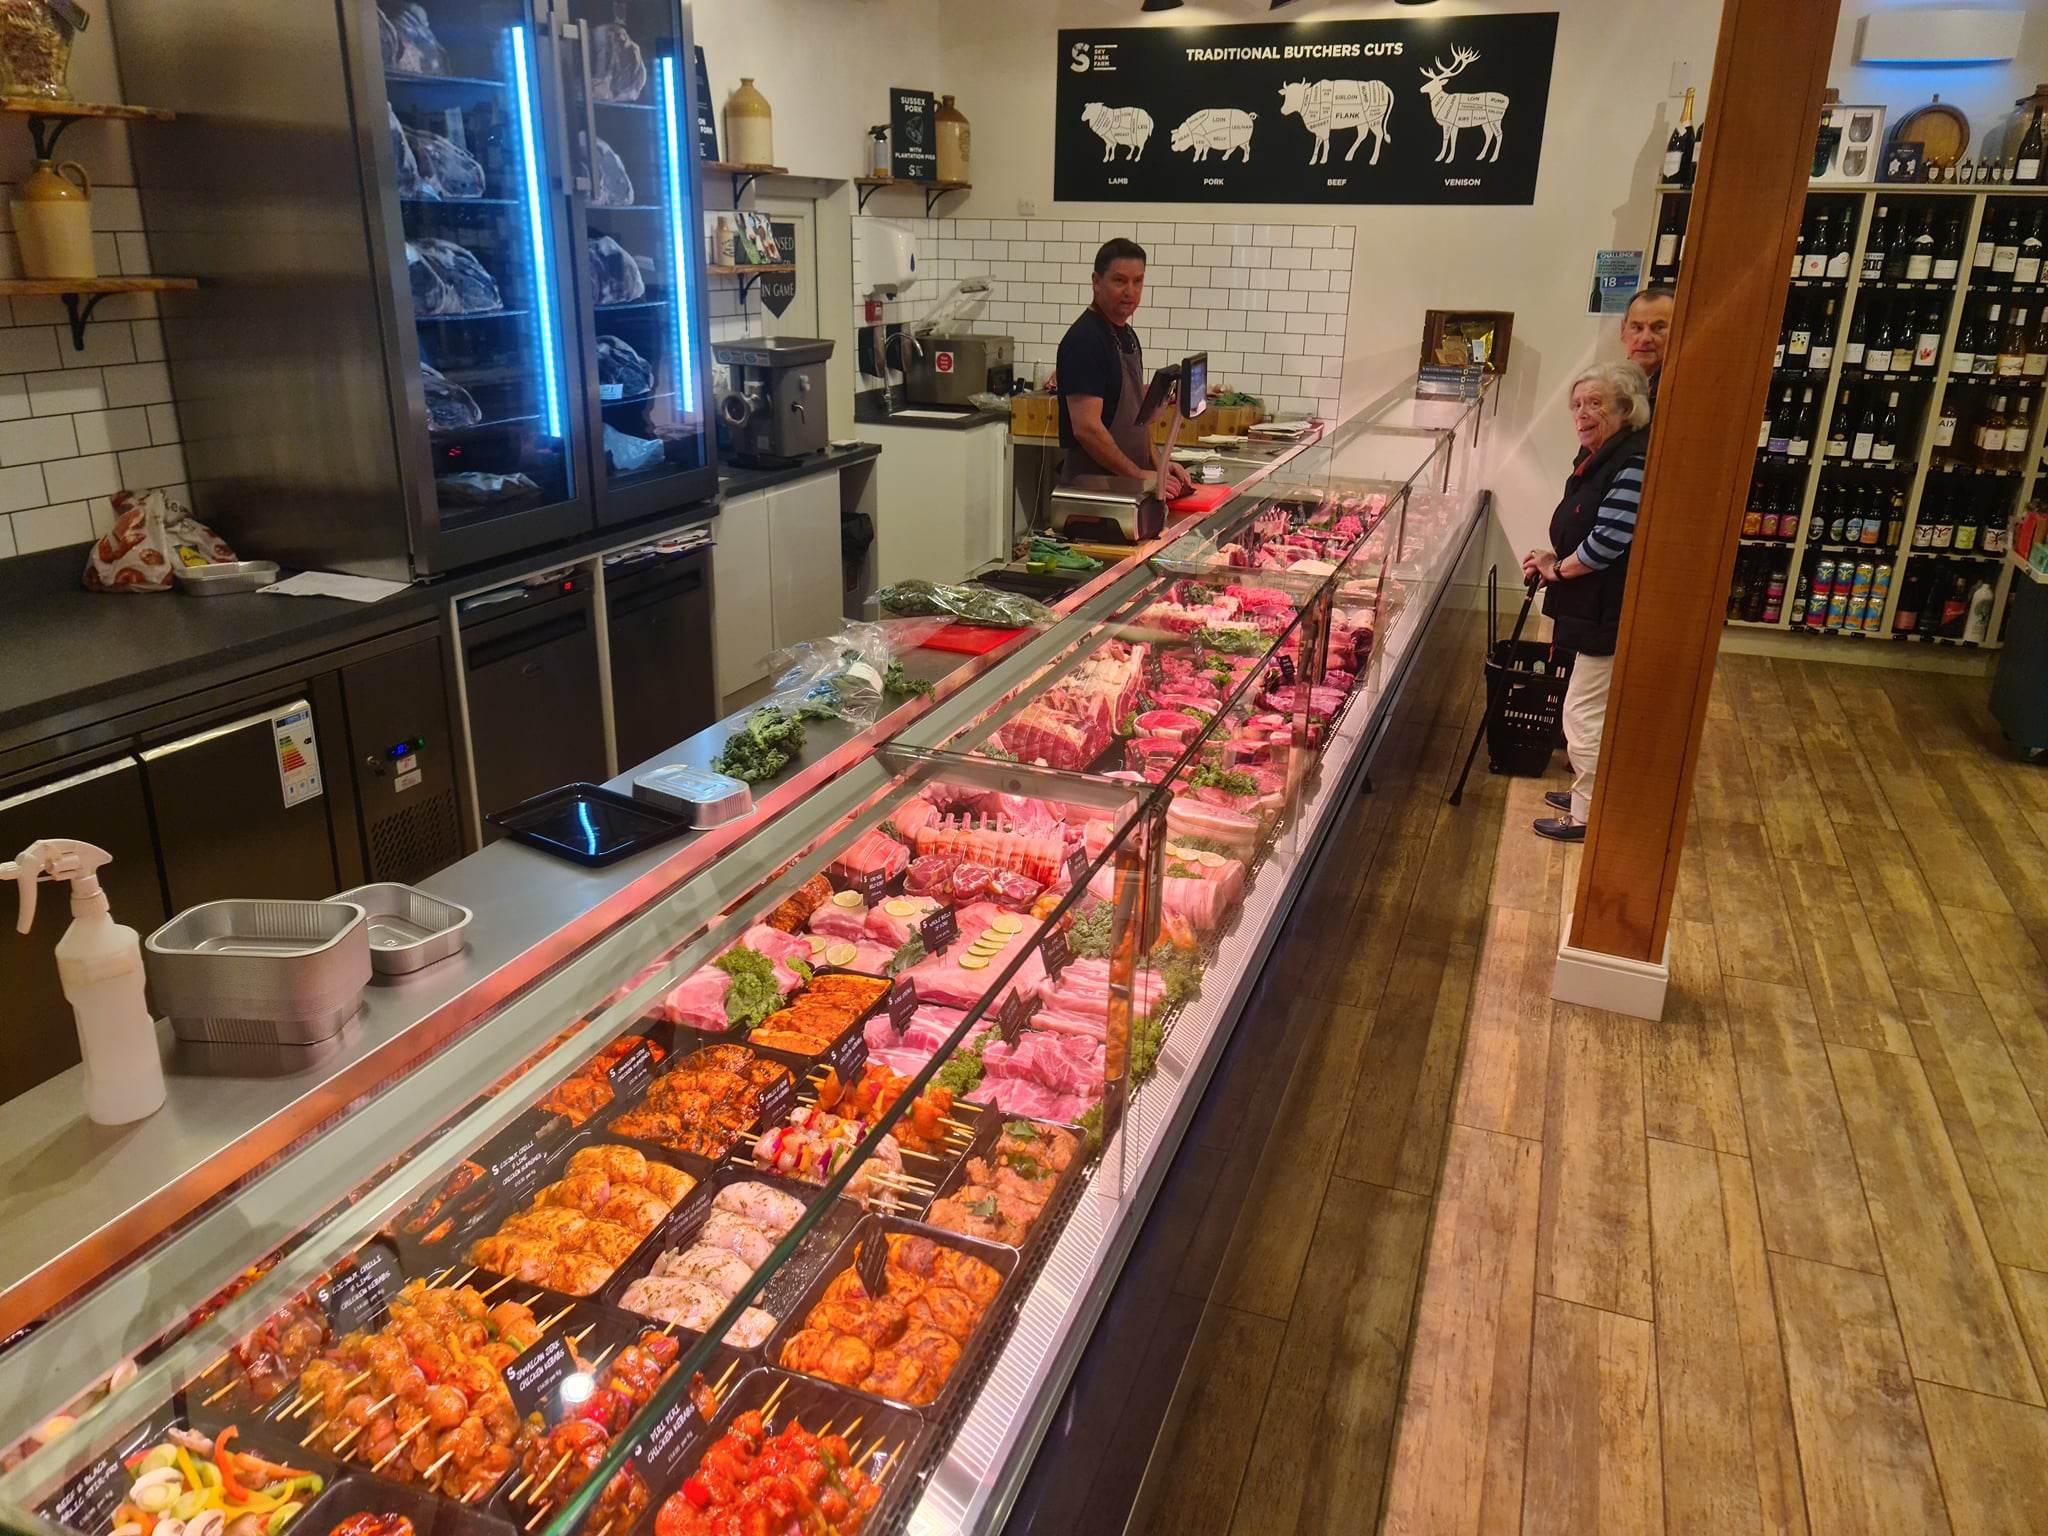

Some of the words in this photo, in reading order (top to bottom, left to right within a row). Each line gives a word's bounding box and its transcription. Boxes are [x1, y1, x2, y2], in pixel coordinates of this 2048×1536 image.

[1186, 48, 1280, 61] TRADITIONAL
[1284, 44, 1361, 59] BUTCHERS
[1364, 43, 1403, 56] CUTS
[901, 96, 926, 106] SUSSEX
[904, 105, 923, 113] PORK
[895, 152, 924, 160] PLANTATION
[762, 283, 771, 297] IN
[773, 283, 794, 297] GAME
[1603, 277, 1617, 287] 18
[491, 1165, 499, 1176] S
[318, 1289, 329, 1303] S
[359, 1254, 384, 1275] CHILLI
[355, 1271, 375, 1288] LIME
[341, 1288, 368, 1311] CHICKEN
[367, 1270, 391, 1291] KEBABS
[507, 1366, 516, 1380] S
[516, 1352, 545, 1380] JAMAICAN
[544, 1339, 560, 1356] JERK
[519, 1366, 544, 1391] CHICKEN
[543, 1348, 565, 1371] KEBABS
[647, 1428, 674, 1464] CHICKEN
[673, 1402, 695, 1432] KEBABS
[650, 1420, 666, 1443] PIRI
[665, 1402, 681, 1425] PIRI
[56, 1489, 76, 1514] BEEF
[83, 1458, 109, 1485] BLACK
[60, 1496, 85, 1525] ARLIC
